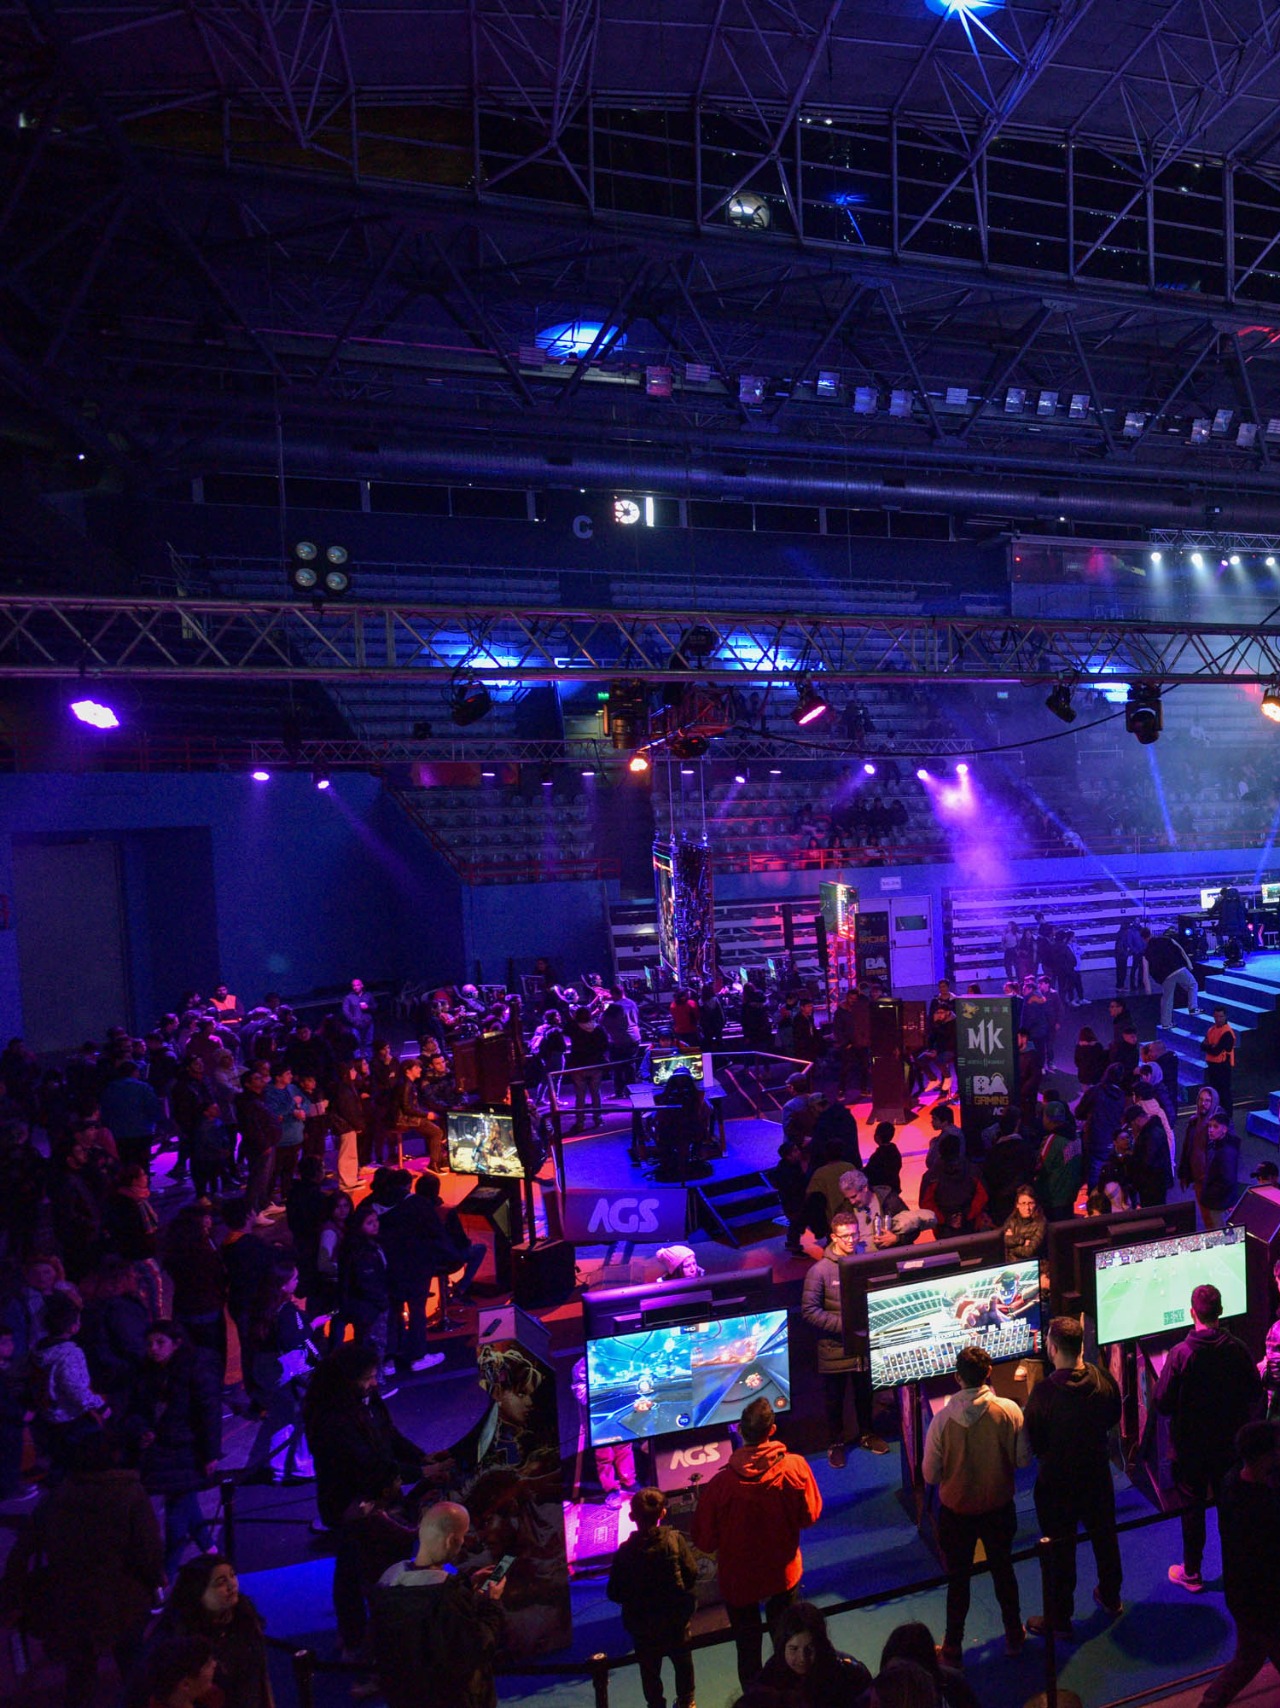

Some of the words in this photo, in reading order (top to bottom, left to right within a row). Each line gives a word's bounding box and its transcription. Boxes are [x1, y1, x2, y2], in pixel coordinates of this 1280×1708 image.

[572, 515, 594, 539] C
[865, 955, 887, 969] BA
[967, 1019, 1004, 1055] MK
[973, 1072, 1009, 1095] BA
[973, 1095, 1009, 1106] GAMING
[587, 1198, 660, 1233] AGS
[670, 1442, 720, 1470] AGS
